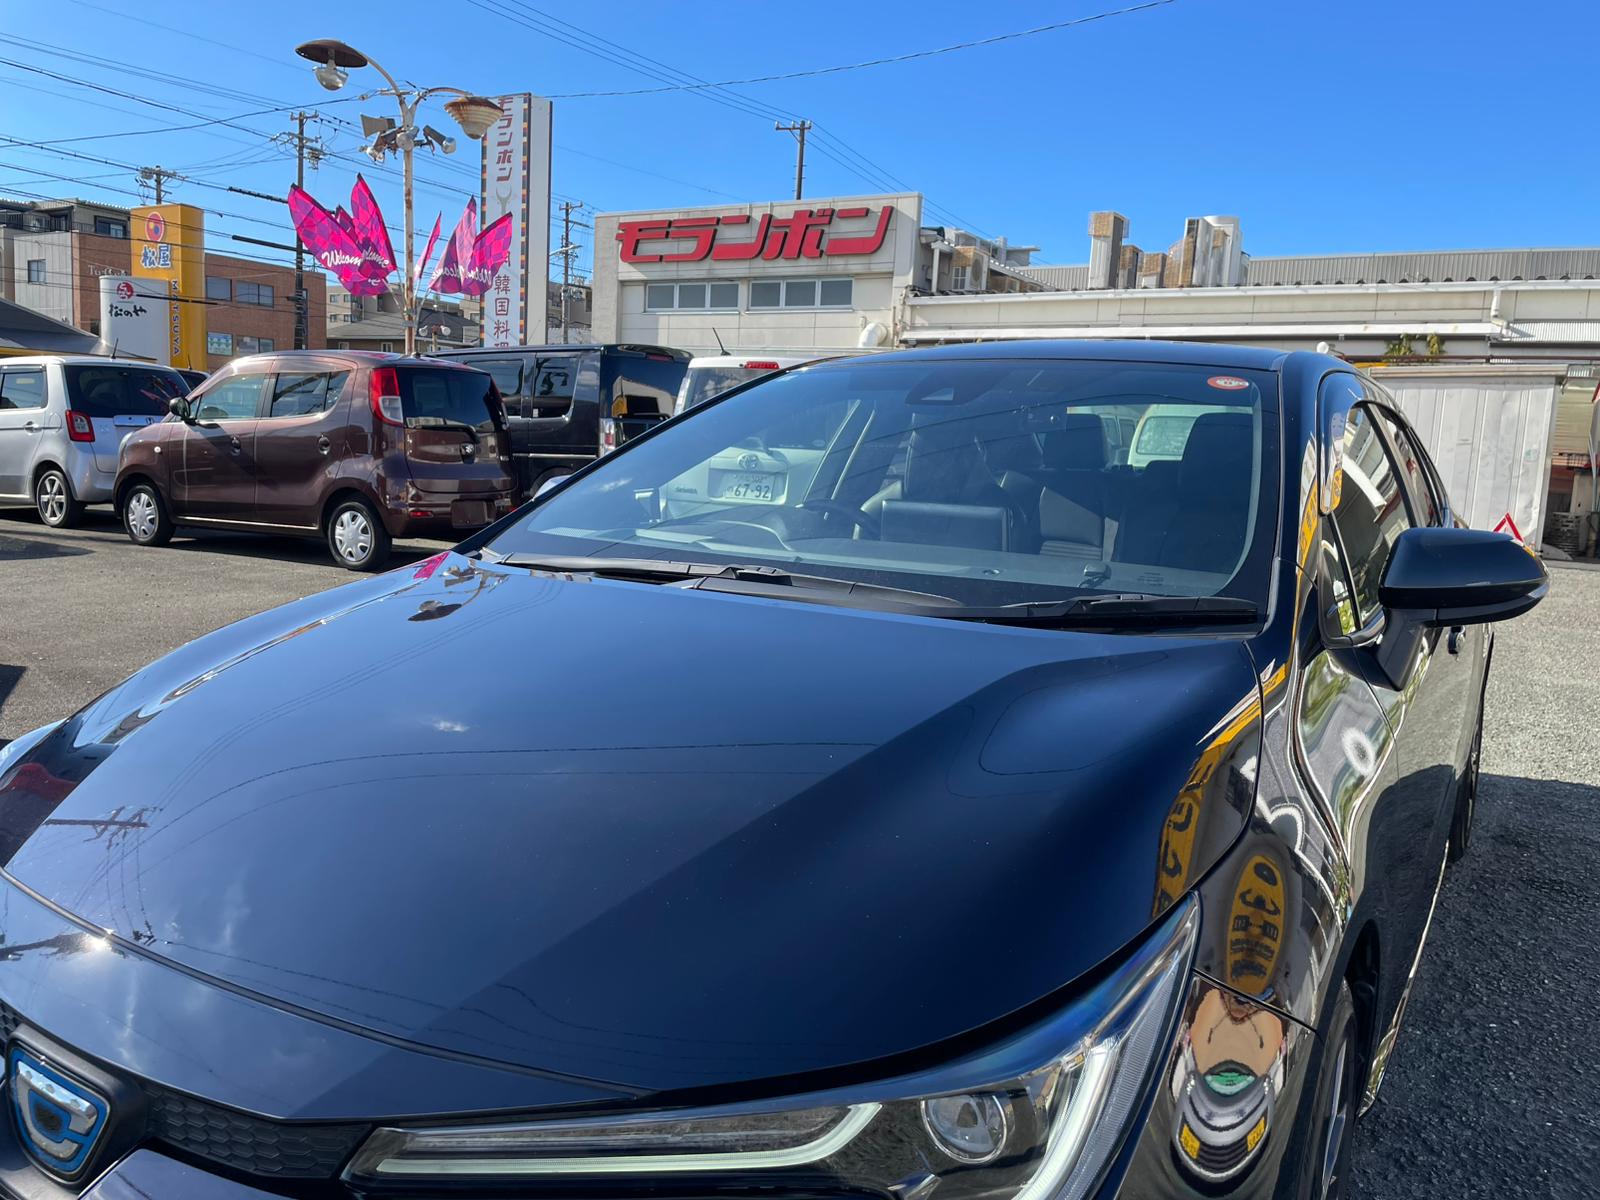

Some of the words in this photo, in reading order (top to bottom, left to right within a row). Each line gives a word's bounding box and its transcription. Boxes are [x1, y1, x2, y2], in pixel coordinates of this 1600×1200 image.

[141, 244, 172, 268] 松屋
[615, 205, 894, 263] モランボン
[171, 279, 181, 355] MATSUYA
